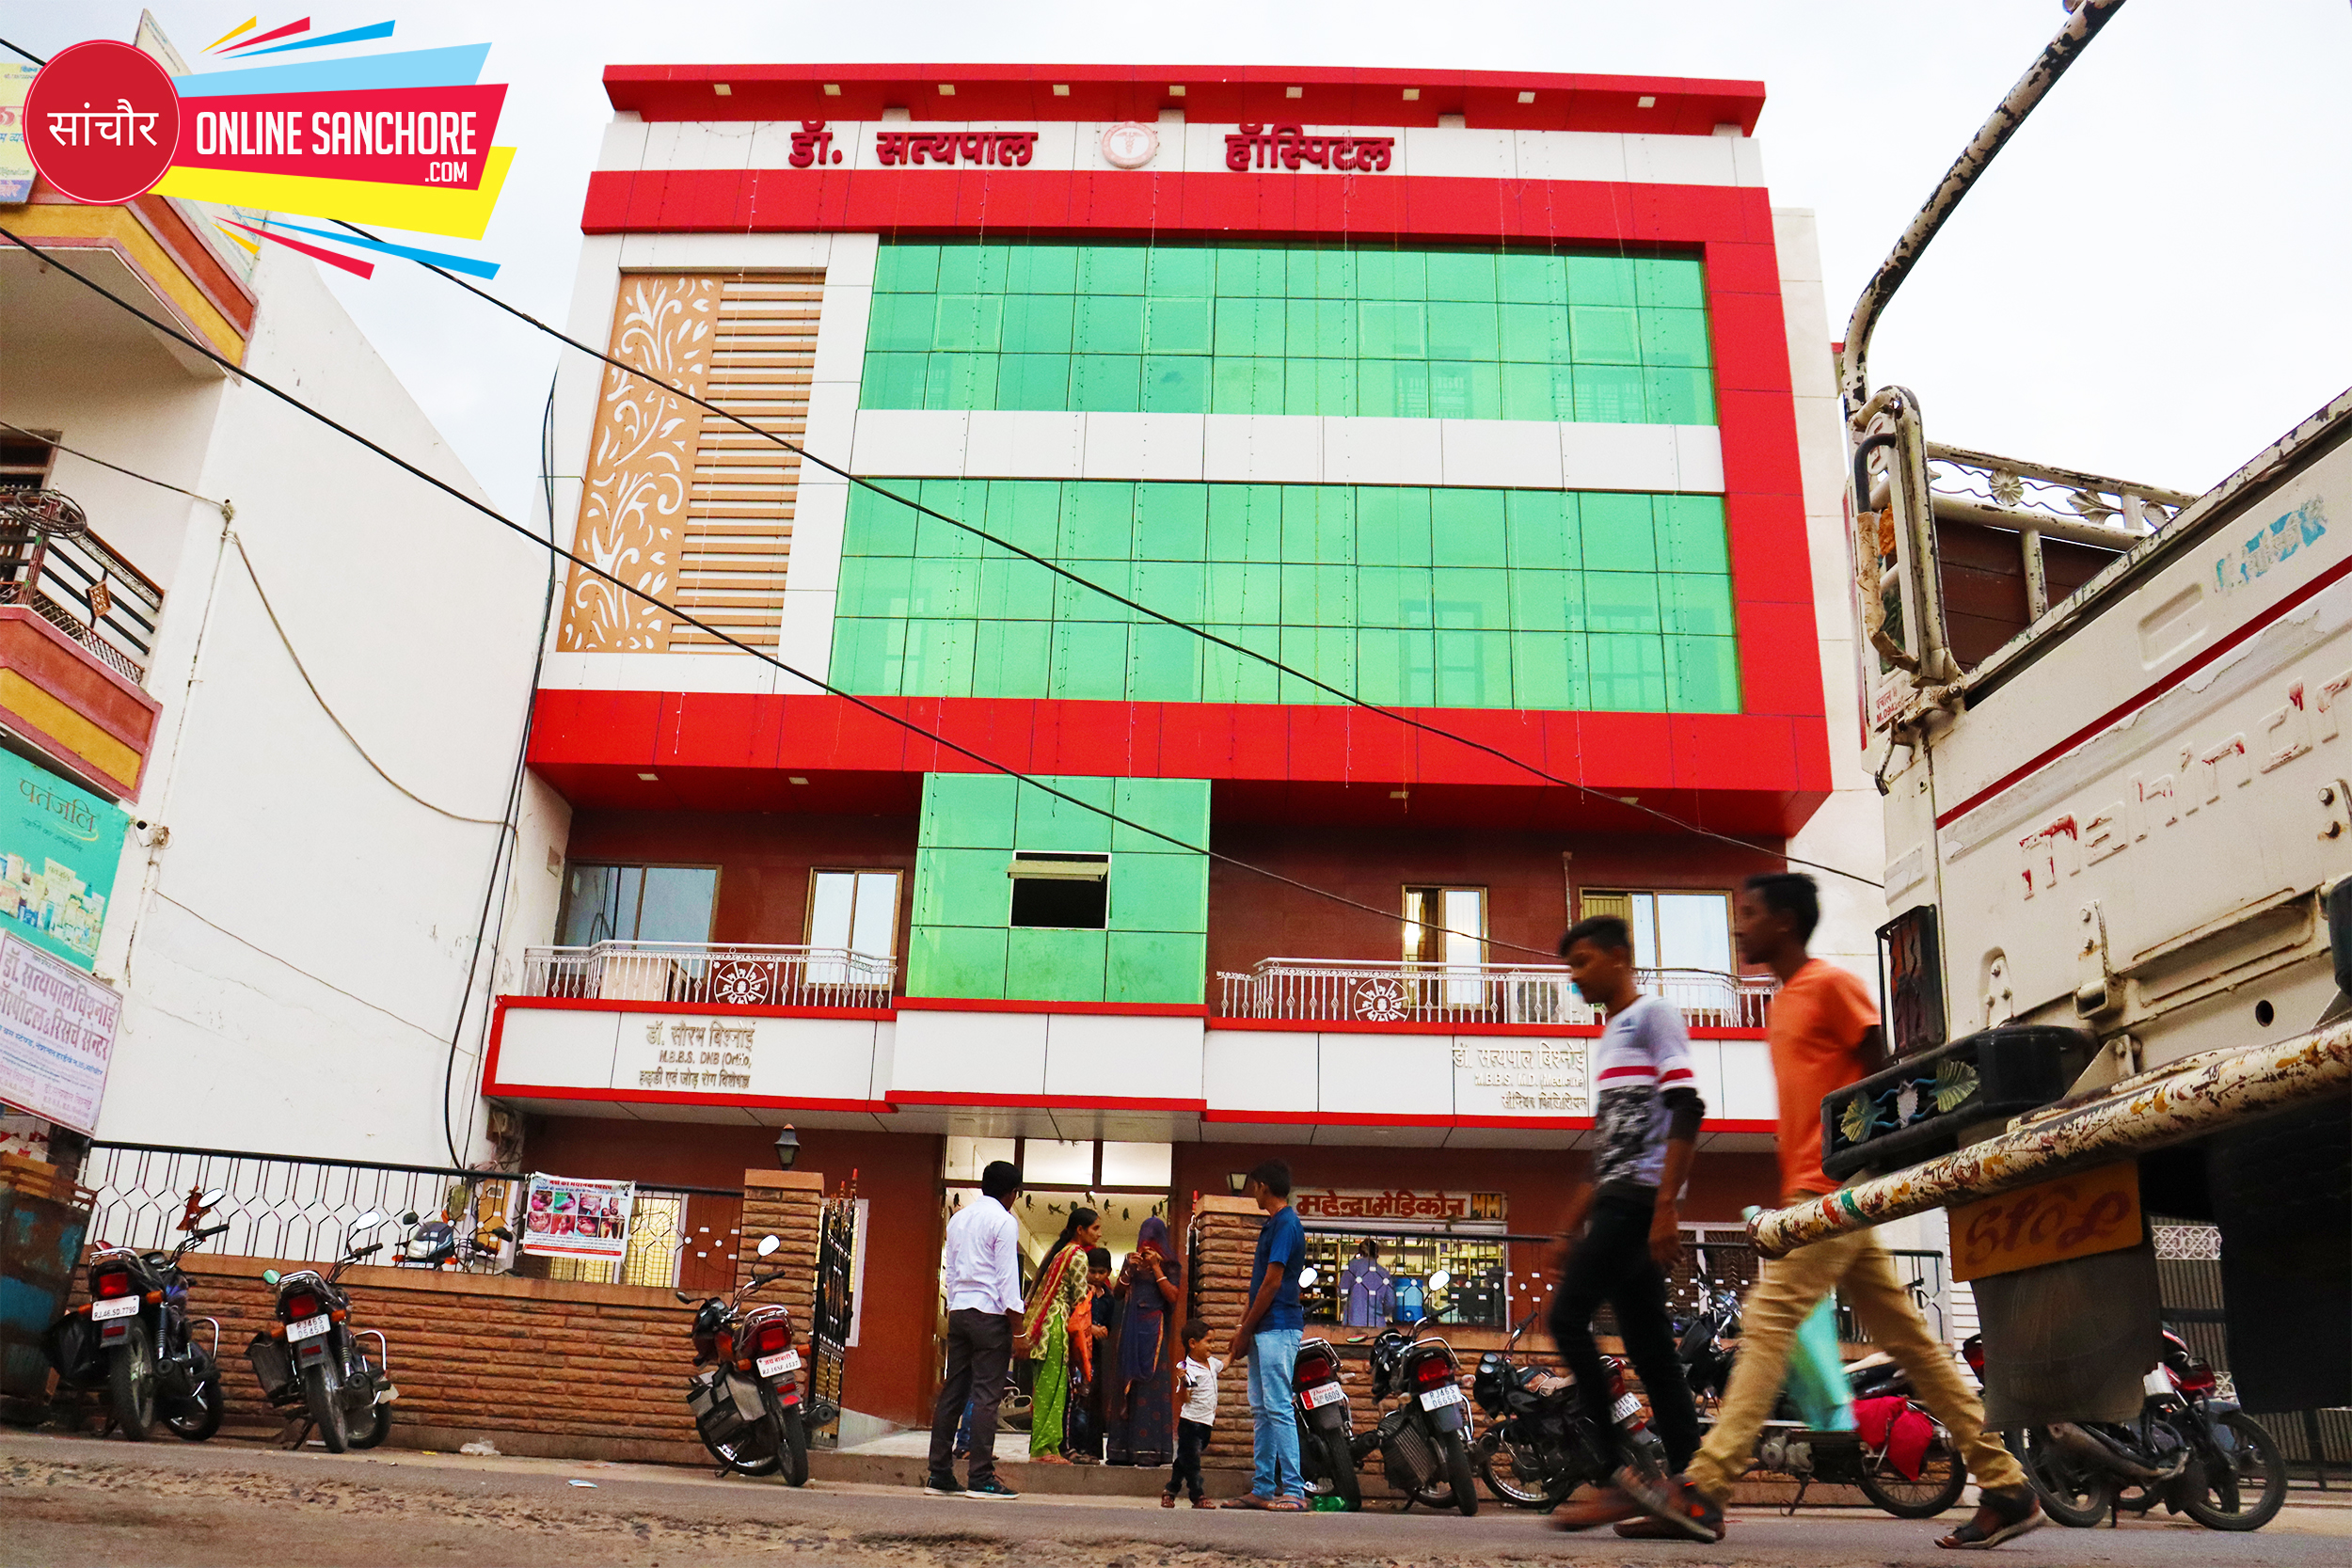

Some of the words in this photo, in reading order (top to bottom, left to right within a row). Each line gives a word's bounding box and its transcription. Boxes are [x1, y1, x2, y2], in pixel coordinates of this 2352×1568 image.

[788, 120, 843, 167] डॉ.
[876, 132, 1039, 166] सत्यपाल
[1225, 123, 1395, 171] हॉस्पिटल
[20, 778, 97, 832] पतंजलि
[23, 962, 75, 1009] सत्यपाल
[0, 980, 47, 1031] ॉस्पीटल
[49, 1007, 83, 1049] रिसर्च
[646, 1021, 665, 1046] डॉ.
[700, 1052, 720, 1065] DNB
[1452, 1043, 1472, 1069] डॉ.
[1478, 1047, 1535, 1069] सत्यपाल
[666, 1069, 677, 1087] एवं
[702, 1069, 717, 1086] रोग
[1474, 1073, 1513, 1086] M.B.B.S.
[1518, 1073, 1538, 1086] M.D.
